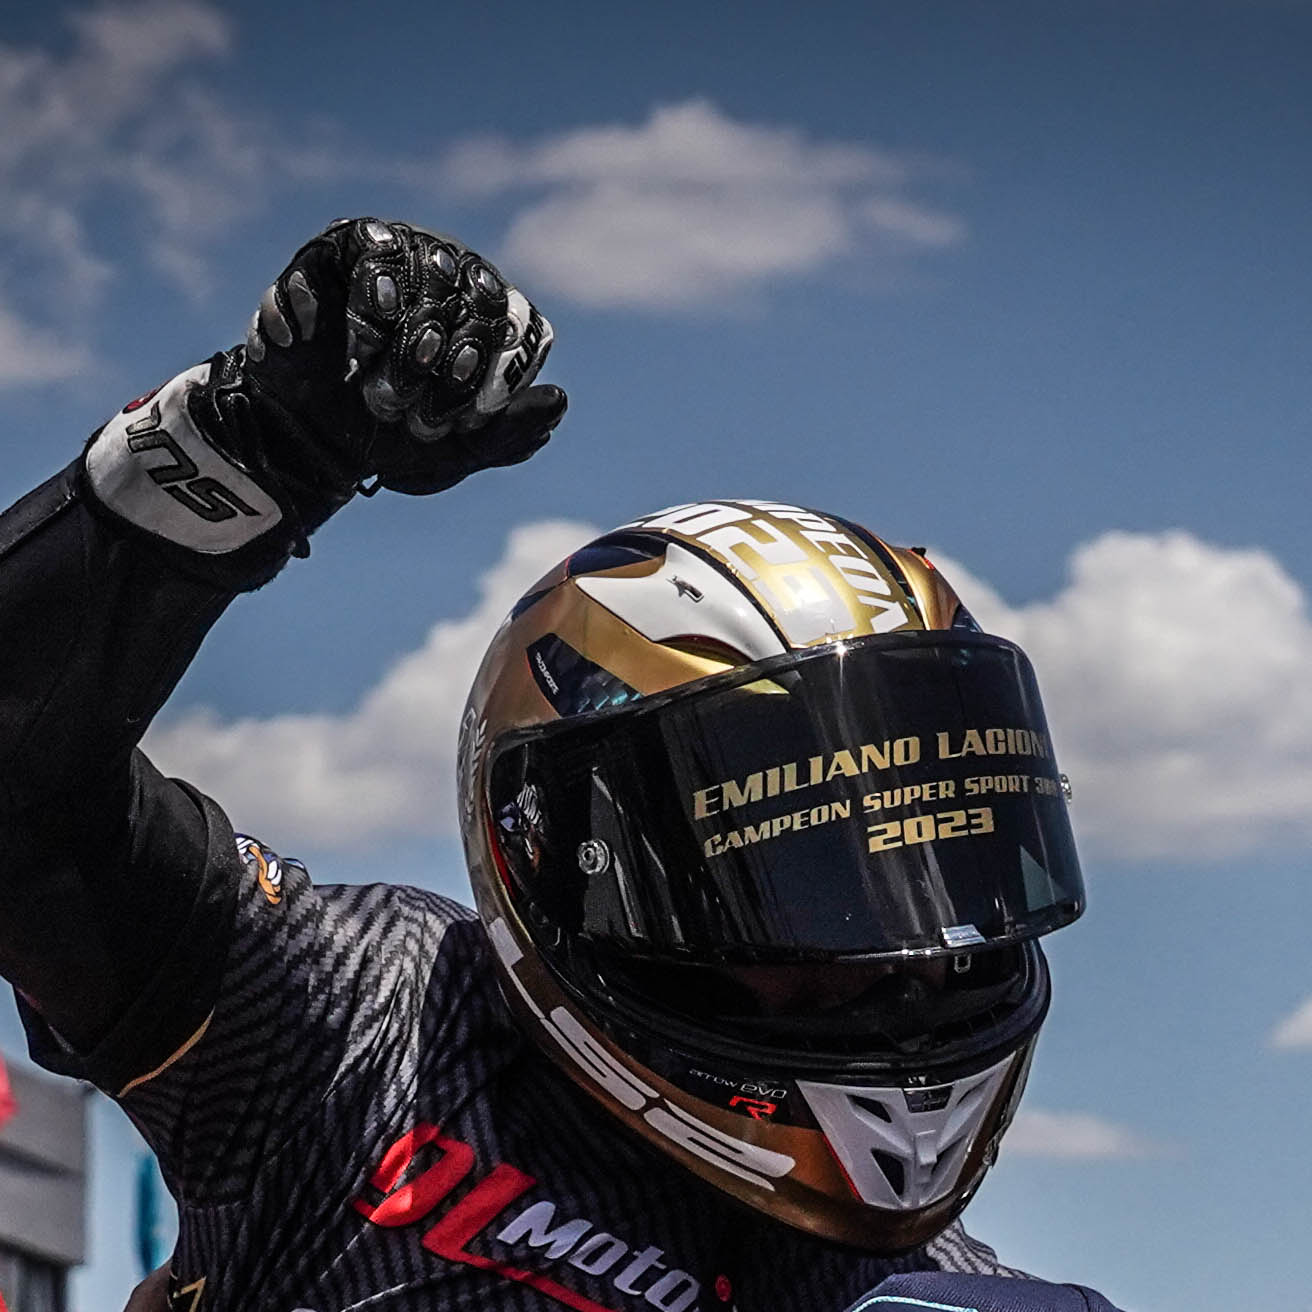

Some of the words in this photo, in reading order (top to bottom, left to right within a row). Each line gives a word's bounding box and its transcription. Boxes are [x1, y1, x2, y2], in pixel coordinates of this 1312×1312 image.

[693, 735, 921, 820] EMILIANO
[704, 800, 851, 858] CAMPEON
[862, 780, 956, 814] SUPER
[964, 775, 1031, 797] SPORT
[868, 808, 995, 854] 2023
